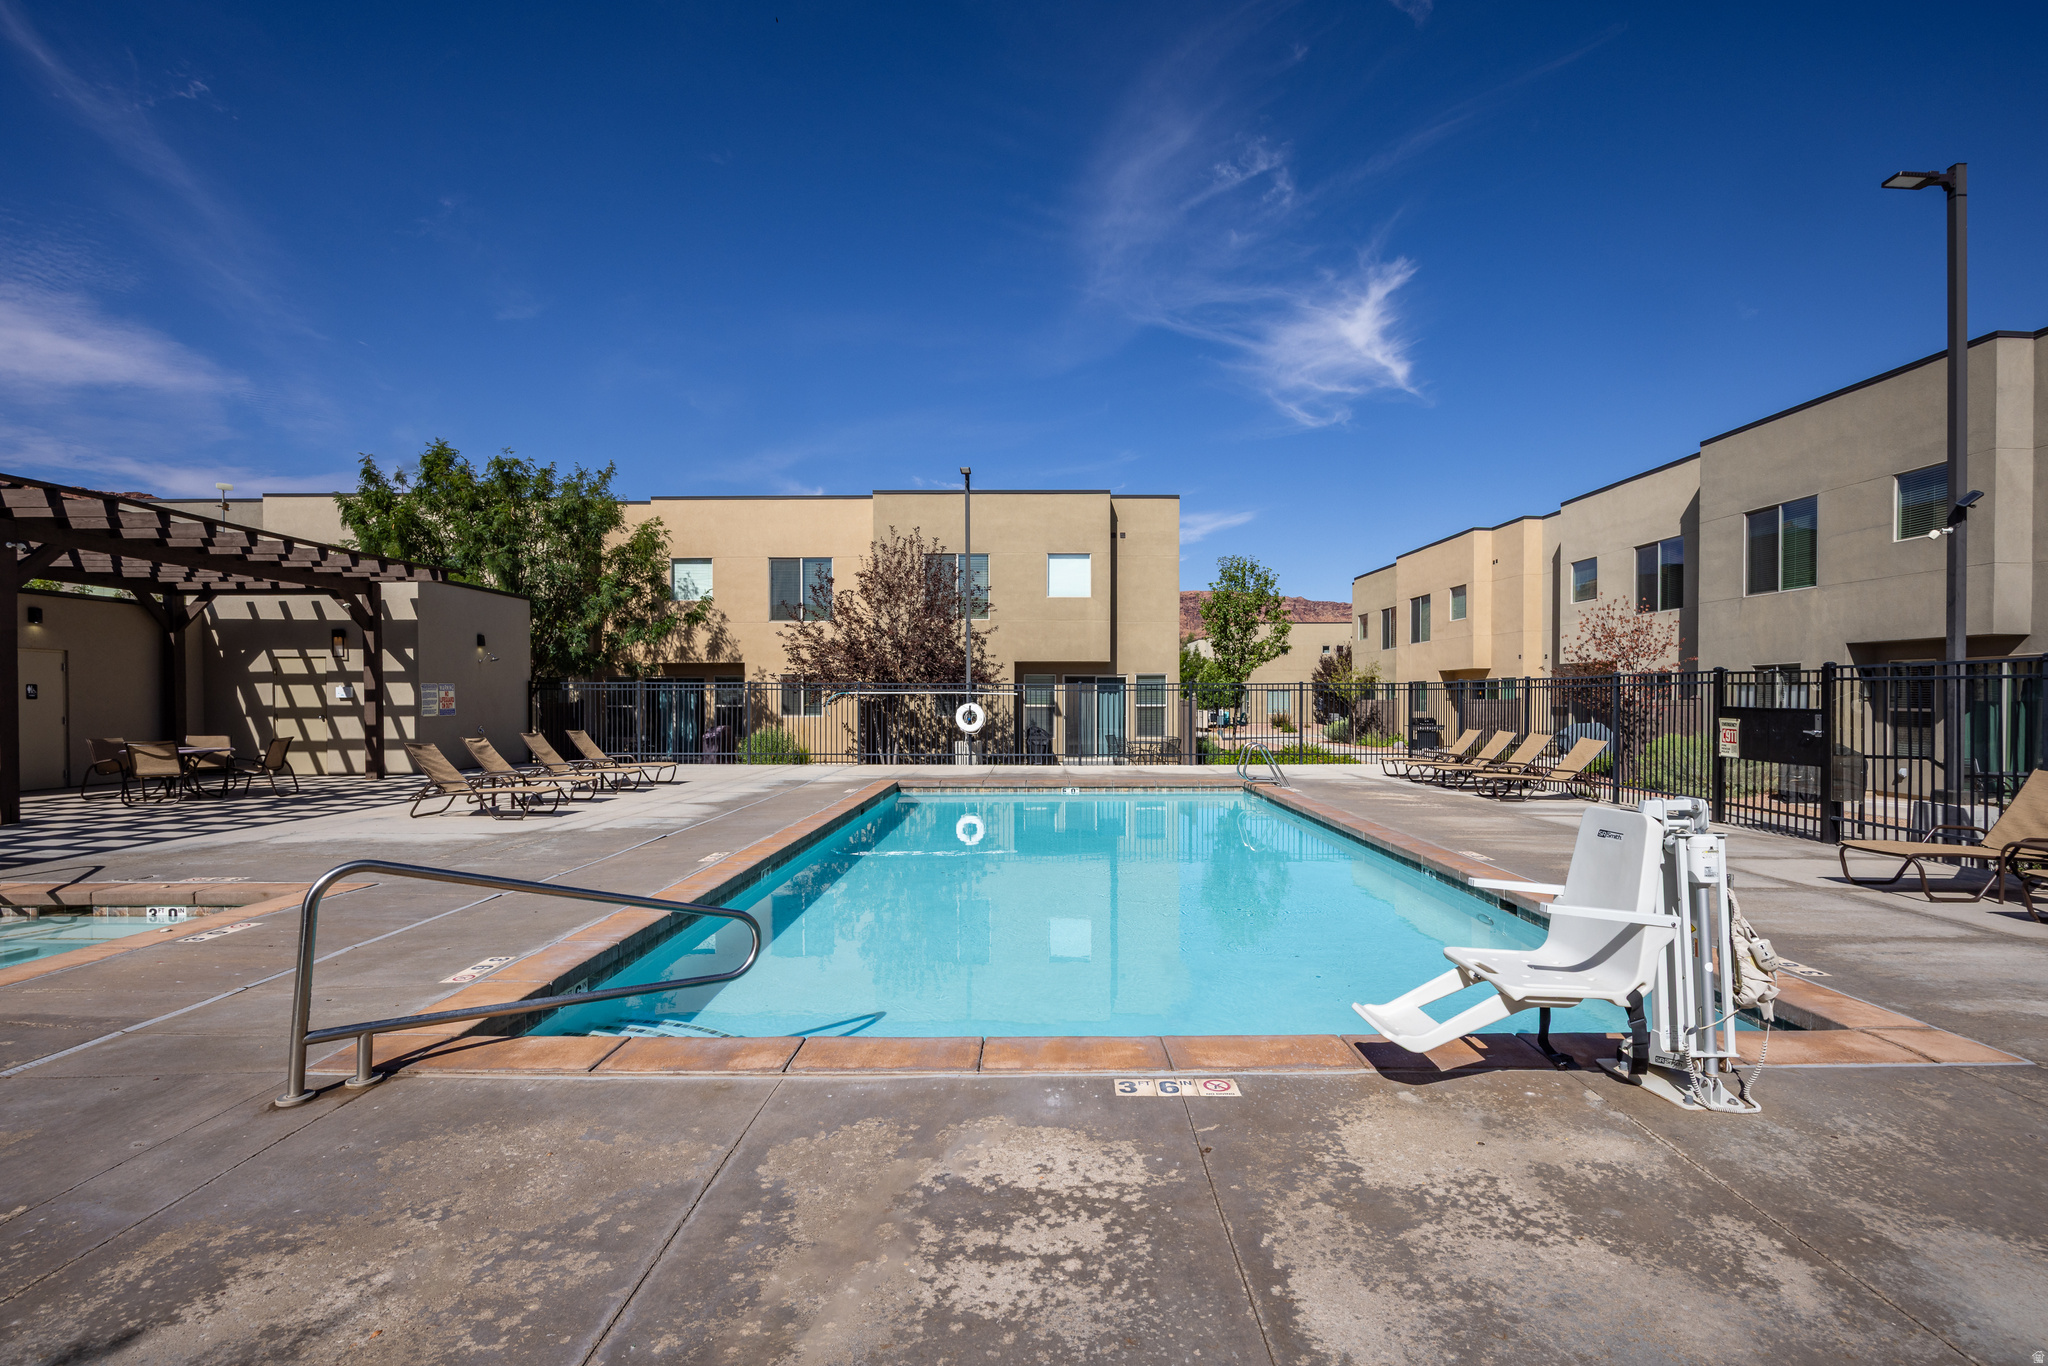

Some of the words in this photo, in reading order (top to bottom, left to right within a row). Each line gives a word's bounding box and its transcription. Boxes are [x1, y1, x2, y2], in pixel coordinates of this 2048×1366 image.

[1726, 730, 1737, 742] 911
[1118, 1080, 1138, 1094] 3
[1159, 1080, 1180, 1094] 6
